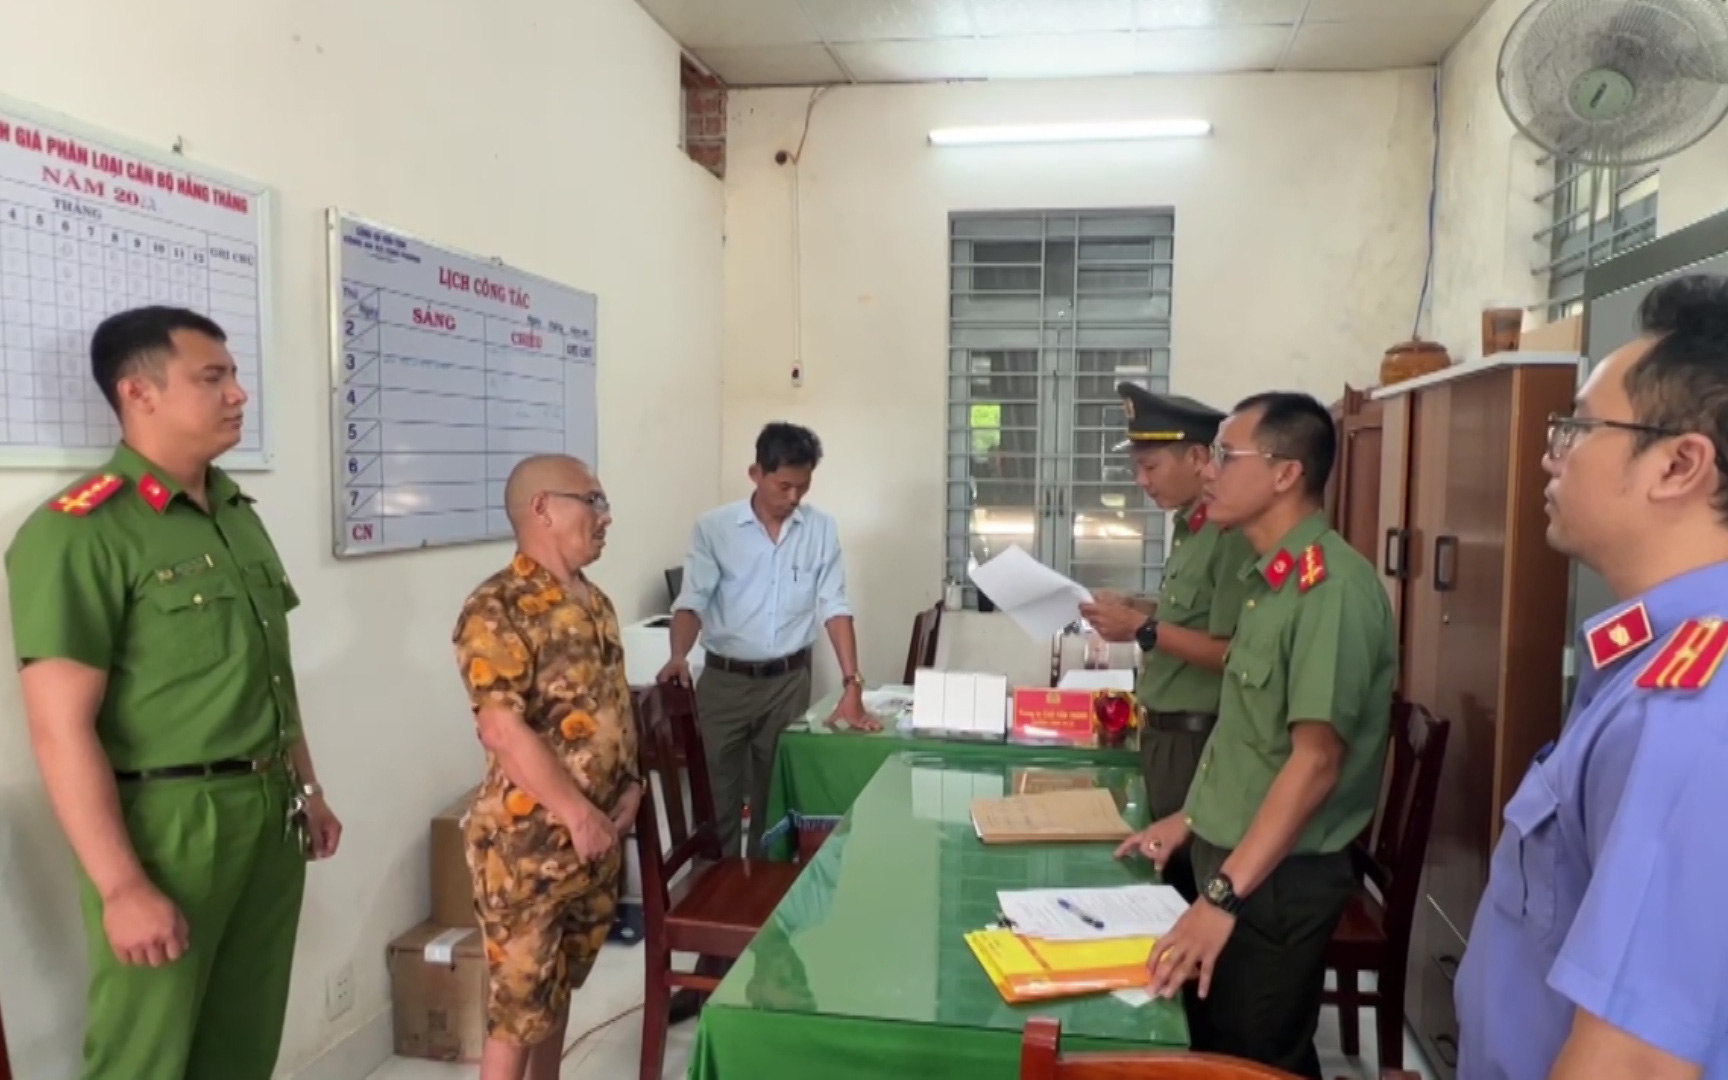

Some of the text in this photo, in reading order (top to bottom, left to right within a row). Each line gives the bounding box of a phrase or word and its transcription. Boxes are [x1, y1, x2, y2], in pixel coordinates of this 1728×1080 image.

[42, 165, 104, 197] NĂM
[92, 150, 123, 178] LOẠI
[213, 190, 248, 215] THÁNG
[53, 197, 102, 219] THÁNG
[9, 207, 16, 220] 4
[36, 213, 44, 226] 5
[61, 220, 70, 232] 6
[87, 226, 95, 238] 7
[111, 232, 119, 243] 8
[133, 238, 141, 248] 9
[153, 242, 165, 254] 10
[174, 247, 184, 258] 11
[438, 265, 530, 309] LỊCH CÔNG TÁC
[412, 303, 456, 330] SÁNG
[345, 319, 355, 336] 2
[345, 353, 355, 370] 3
[346, 390, 356, 406] 4
[347, 422, 357, 440] 5
[348, 457, 358, 474] 6
[349, 490, 359, 506] 7
[352, 523, 373, 541] CN
